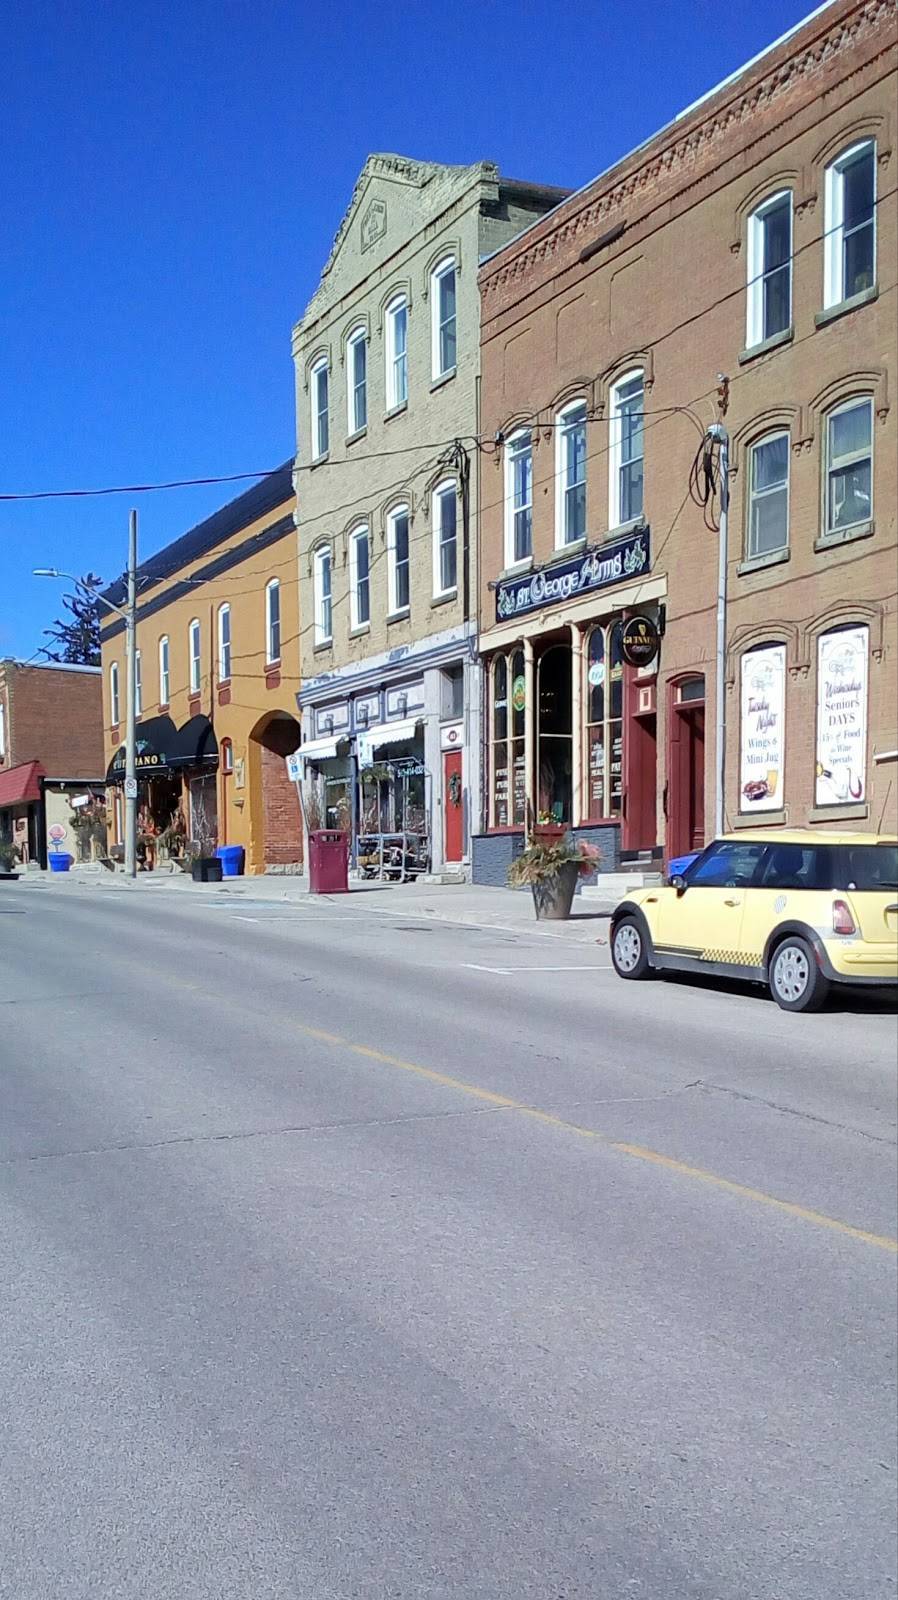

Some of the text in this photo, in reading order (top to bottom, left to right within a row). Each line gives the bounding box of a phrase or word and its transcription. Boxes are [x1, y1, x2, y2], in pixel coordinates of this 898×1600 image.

[530, 571, 578, 603] George
[578, 552, 622, 588] Arms
[828, 713, 855, 726] DAYS
[748, 738, 771, 748] Wings
[747, 752, 779, 764] Mini Jug
